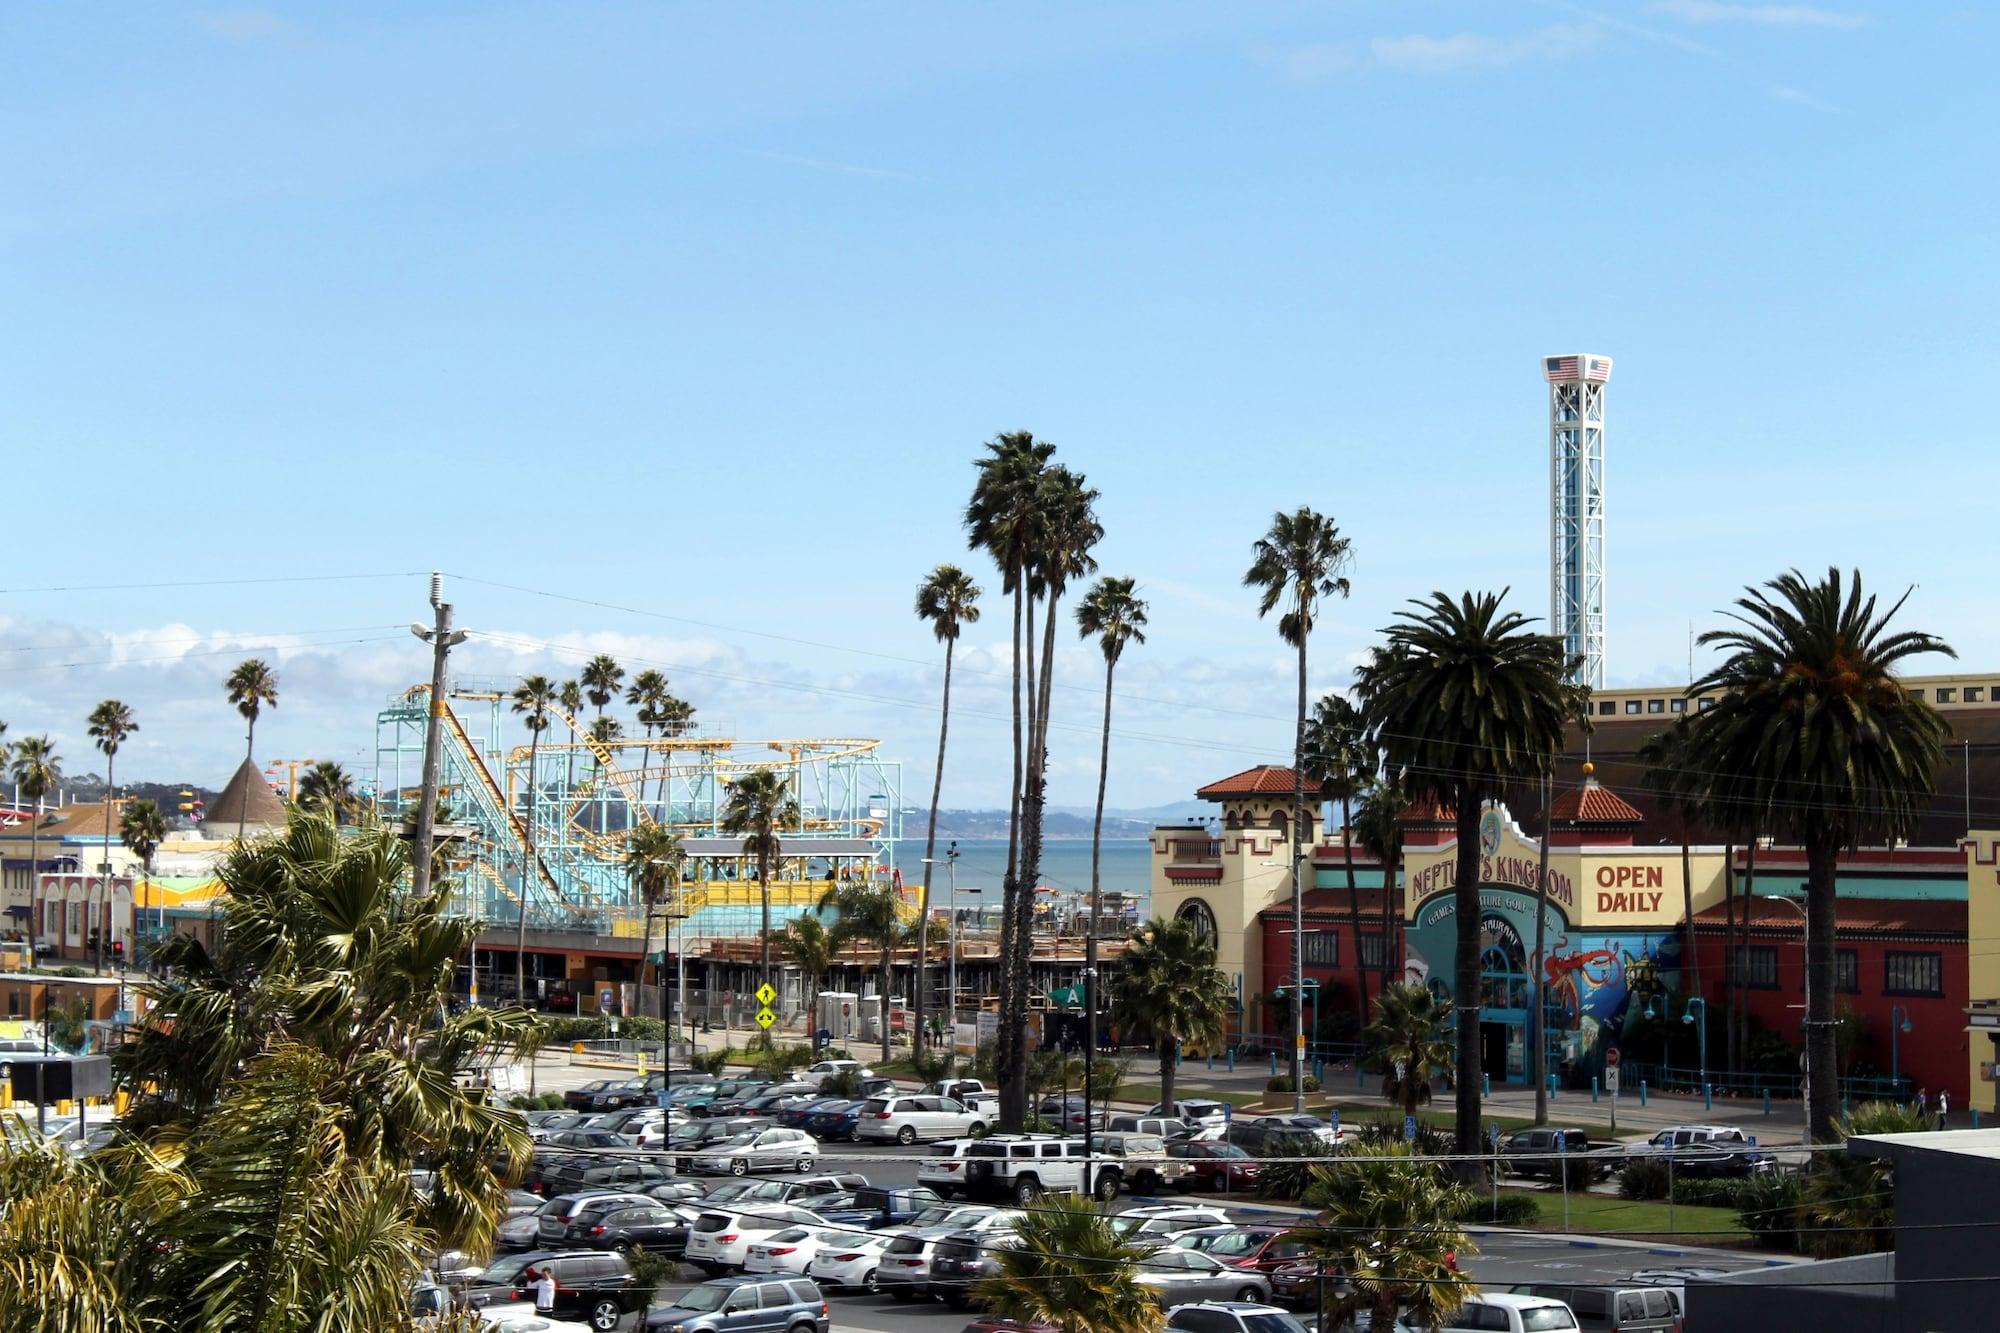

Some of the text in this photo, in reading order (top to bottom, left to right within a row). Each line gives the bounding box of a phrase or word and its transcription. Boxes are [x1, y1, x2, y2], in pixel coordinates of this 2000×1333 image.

[1596, 866, 1663, 888] OPEN
[1428, 903, 1456, 926] GAMES
[1504, 897, 1528, 914] GOLF
[1597, 892, 1664, 912] DAILY
[1480, 919, 1519, 945] STAURANT
[1067, 989, 1079, 1003] A
